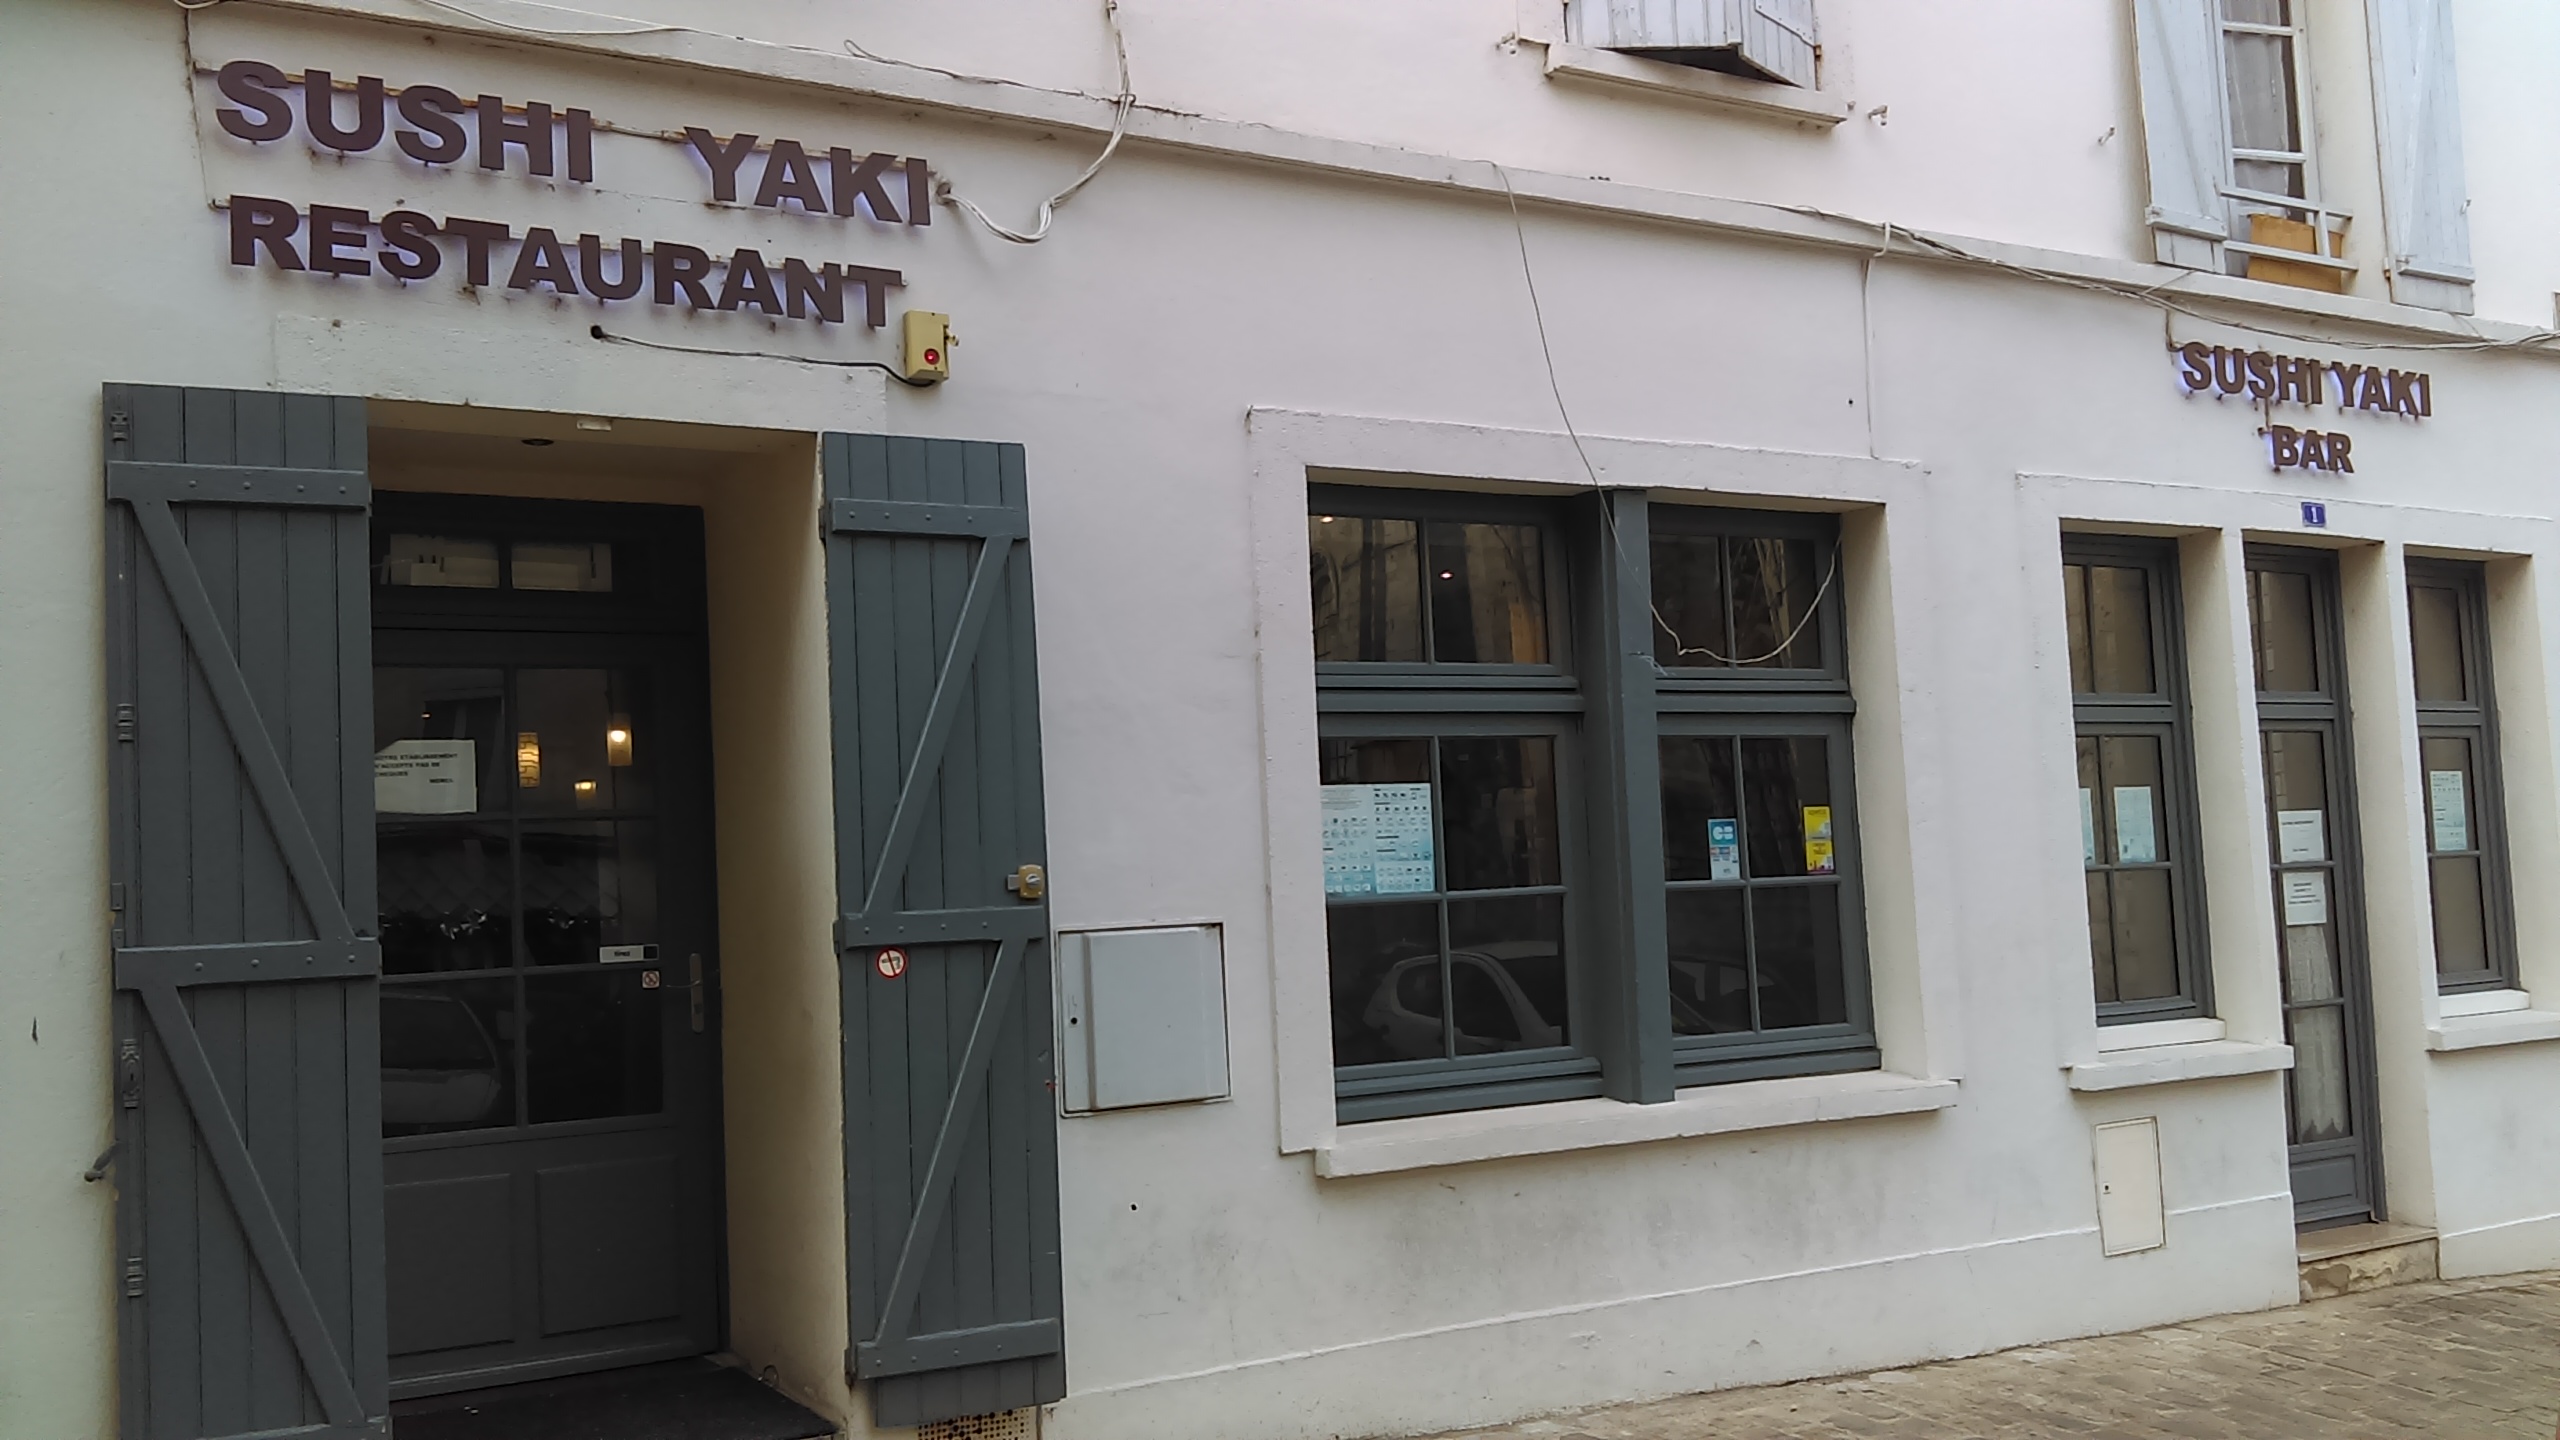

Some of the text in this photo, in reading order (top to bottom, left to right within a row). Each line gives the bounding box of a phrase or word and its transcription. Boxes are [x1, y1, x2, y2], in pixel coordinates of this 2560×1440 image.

[216, 60, 932, 226] SUSHI YAKI
[229, 194, 903, 328] RESTAURANT
[2181, 341, 2432, 417] SUSHI YAKI
[2271, 425, 2354, 473] BAR
[2310, 508, 2319, 523] 1
